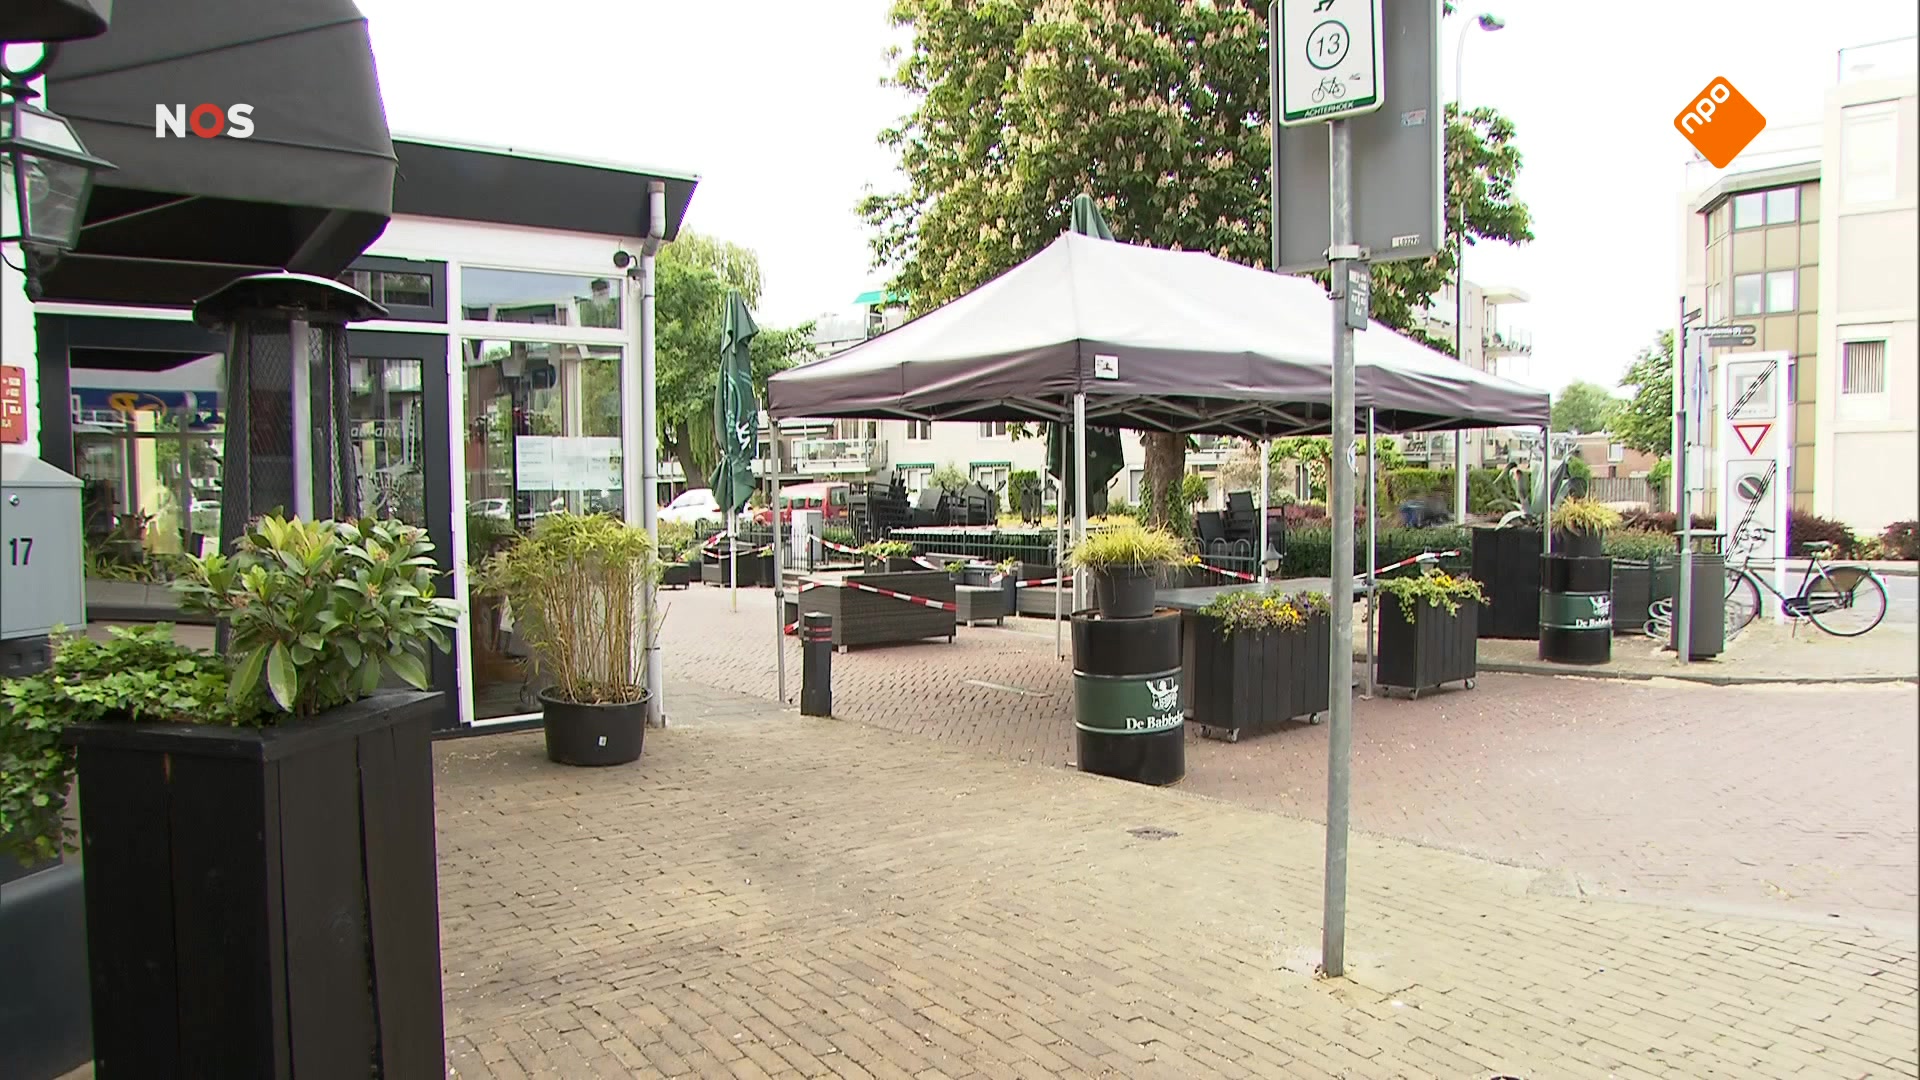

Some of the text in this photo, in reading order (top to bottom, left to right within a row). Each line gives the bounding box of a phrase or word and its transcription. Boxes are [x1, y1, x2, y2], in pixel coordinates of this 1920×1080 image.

[1317, 33, 1340, 57] 13
[1304, 101, 1354, 118] ACHTERHOEK
[10, 537, 33, 566] 17
[1126, 717, 1144, 730] De
